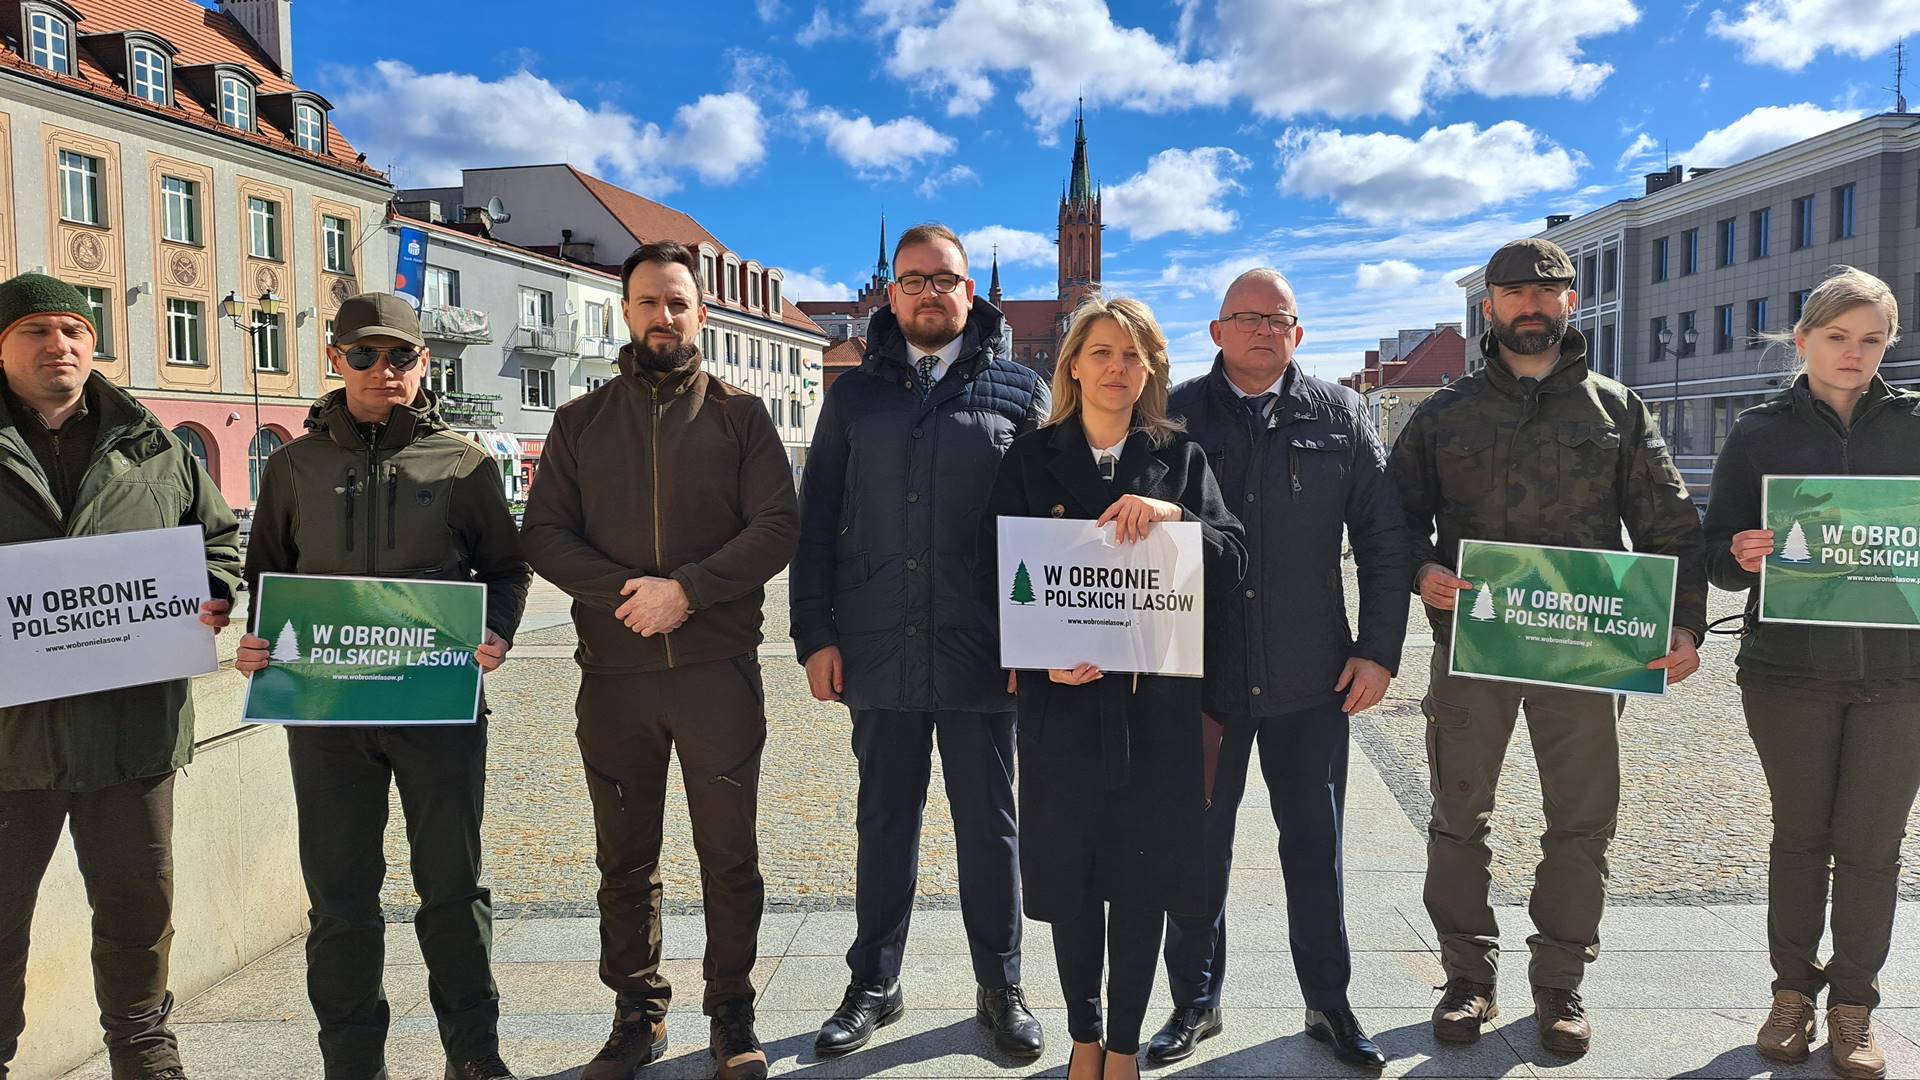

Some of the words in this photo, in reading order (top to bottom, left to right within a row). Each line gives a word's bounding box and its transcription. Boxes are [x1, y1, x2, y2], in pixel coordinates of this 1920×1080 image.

[1821, 525, 1844, 545] W
[1851, 525, 1920, 547] OBRO
[1821, 548, 1919, 567] POLSKICH
[1044, 565, 1062, 586] W
[1069, 566, 1160, 590] OBRONIE
[7, 594, 33, 618] W
[42, 578, 158, 613] OBRONIE
[1045, 590, 1126, 610] POLSKICH
[1132, 590, 1194, 612] LASÓW
[1506, 588, 1526, 607] W
[1531, 590, 1624, 616] OBRONIE
[12, 608, 121, 640] POLSKICH
[128, 595, 200, 624] LASÓW
[1067, 618, 1132, 628] www.wobronielasow.pl
[1505, 609, 1588, 631] POLSKICH
[1594, 617, 1657, 638] LASÓW
[45, 634, 131, 653] www.wobronielasow.pl
[312, 624, 333, 645] W
[339, 625, 436, 648] OBRONIE
[310, 648, 400, 666] POLSKICH
[406, 647, 469, 667] LASÓW
[332, 674, 404, 682] www.wobronielasow.pl
